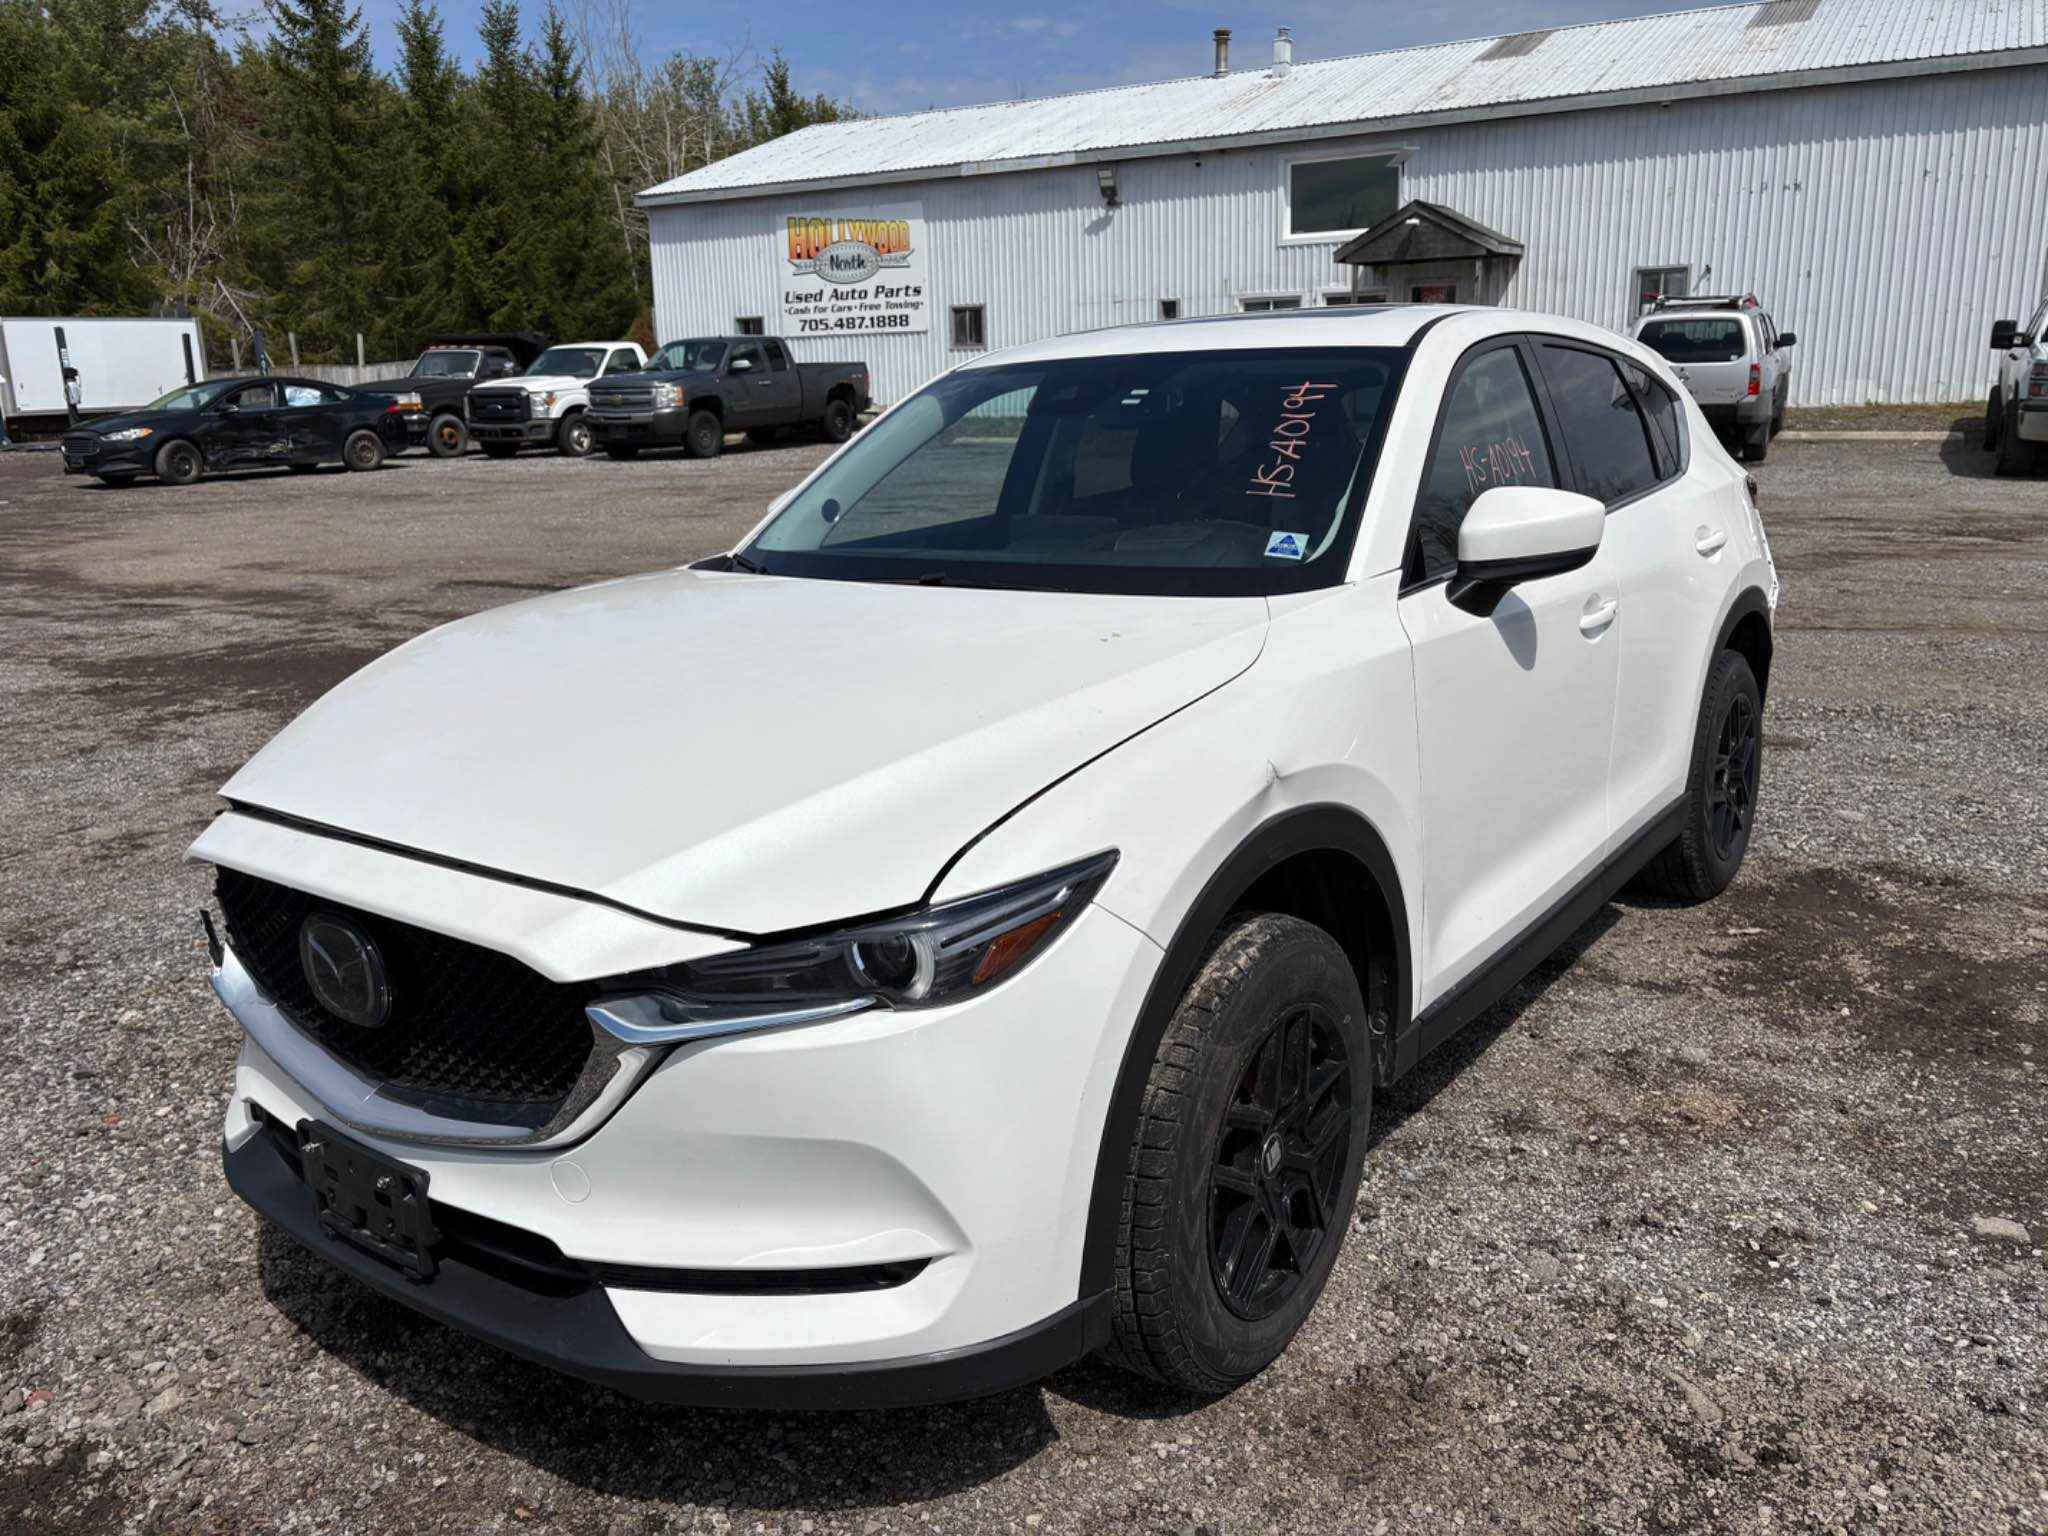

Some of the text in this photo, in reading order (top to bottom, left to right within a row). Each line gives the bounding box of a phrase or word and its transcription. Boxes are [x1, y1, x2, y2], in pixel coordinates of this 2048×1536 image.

[787, 217, 910, 259] HOLLYWOOD
[829, 254, 866, 271] North
[785, 285, 921, 304] Used Auto Parts
[813, 304, 828, 314] for
[831, 303, 853, 313] Cars
[799, 314, 909, 332] 705.487.1888
